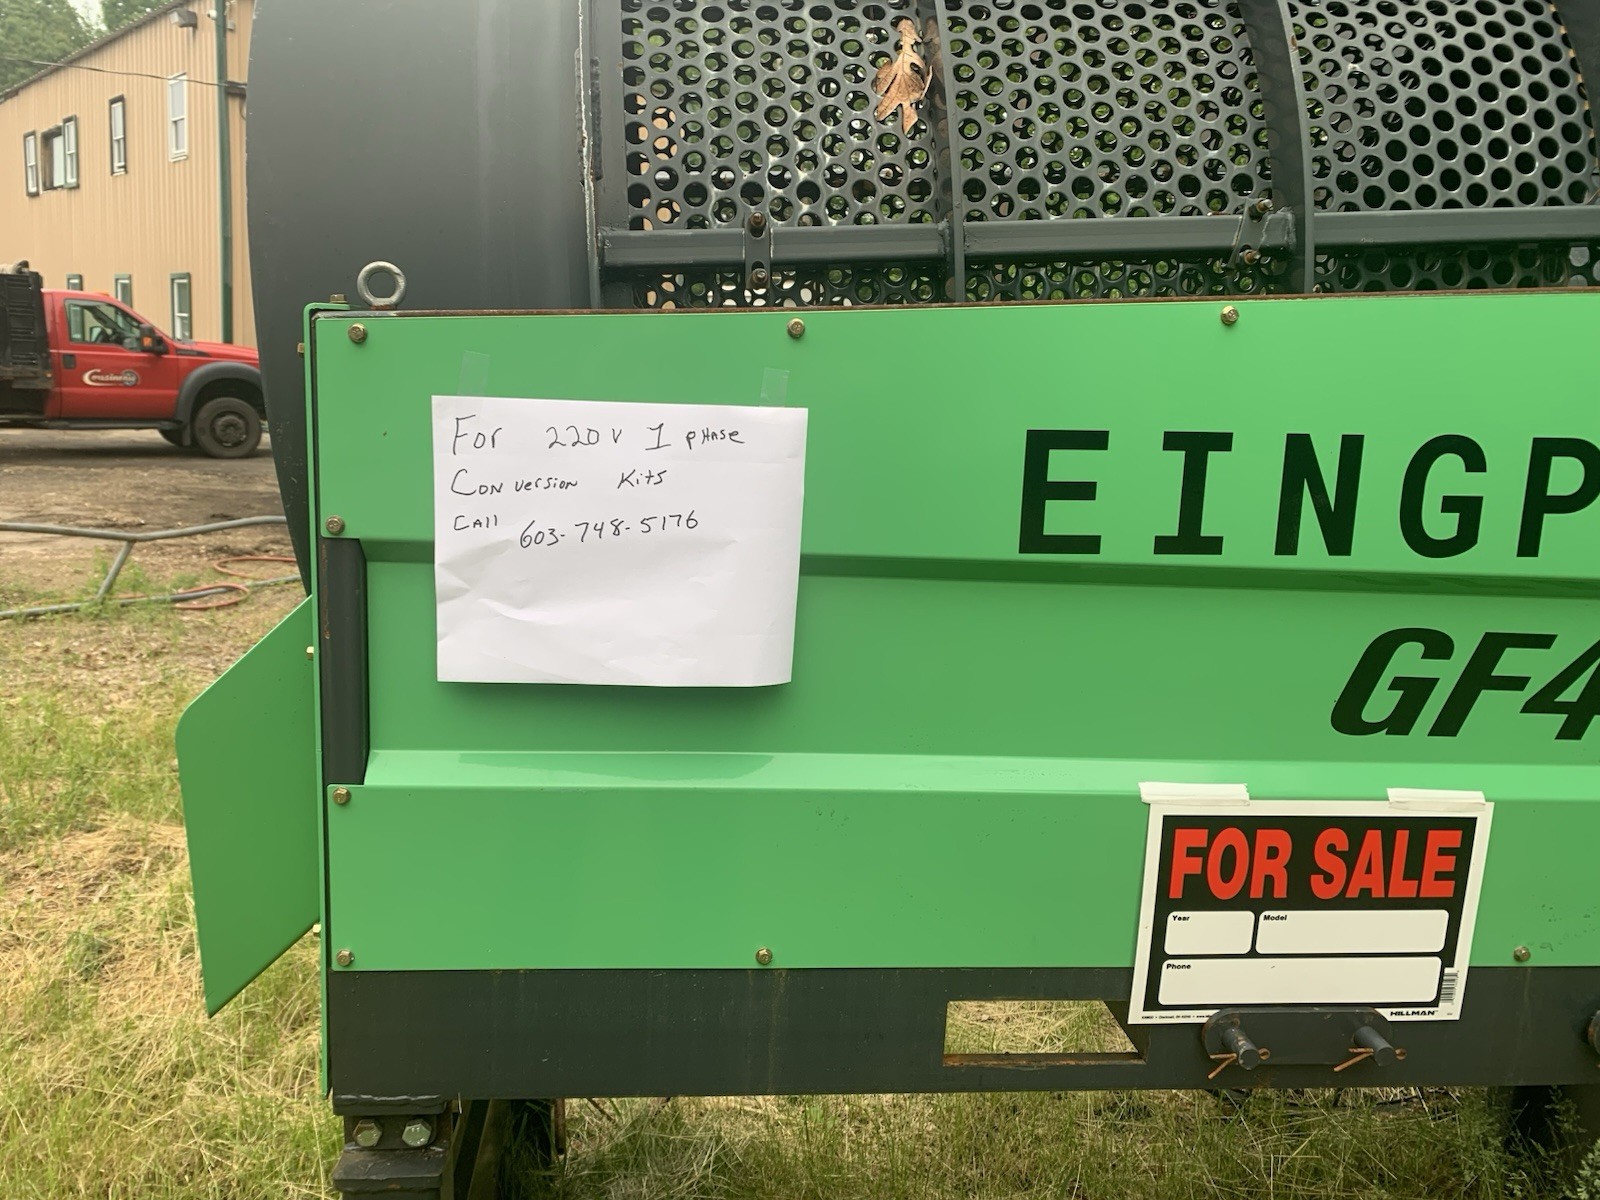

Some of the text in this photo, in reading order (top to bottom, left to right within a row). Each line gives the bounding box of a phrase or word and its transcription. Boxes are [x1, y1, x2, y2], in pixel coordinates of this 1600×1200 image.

[452, 414, 503, 456] For
[546, 425, 600, 449] 220
[617, 468, 667, 490] Kits
[1018, 429, 1600, 559] EINGP
[519, 509, 699, 549] 603-748-5176
[1330, 627, 1600, 741] GF4
[1168, 827, 1463, 900] FOR SALE
